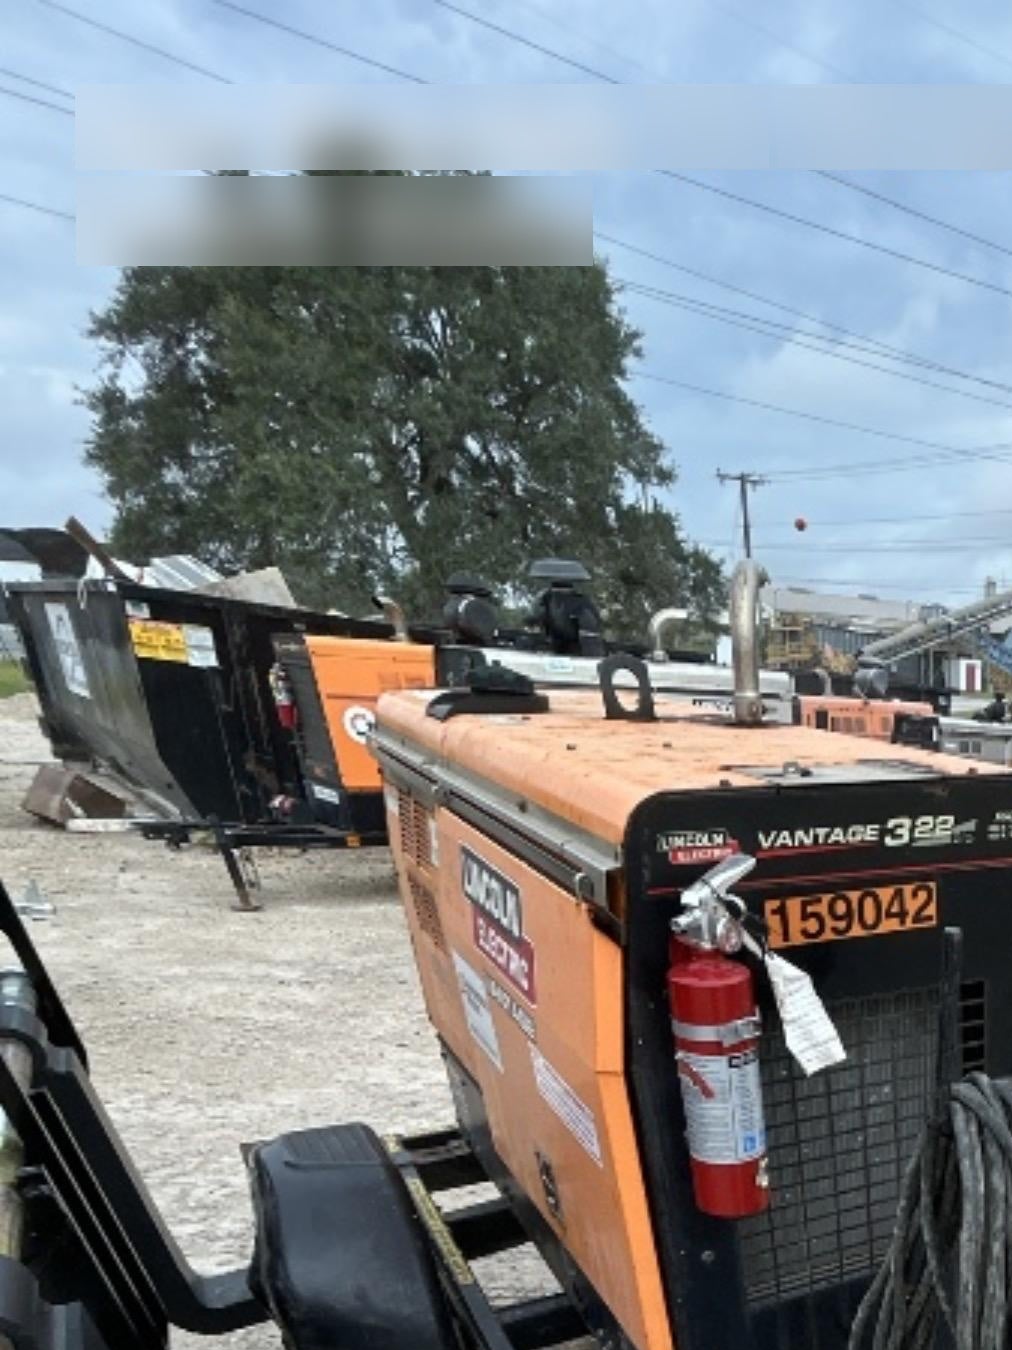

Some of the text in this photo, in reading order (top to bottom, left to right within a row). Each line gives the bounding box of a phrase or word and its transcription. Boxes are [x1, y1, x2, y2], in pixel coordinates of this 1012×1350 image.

[757, 824, 881, 850] VANTAGE
[884, 814, 956, 848] 322
[463, 854, 522, 938] LINCOLN
[770, 883, 935, 943] 159042
[477, 915, 530, 991] ELECTRIC
